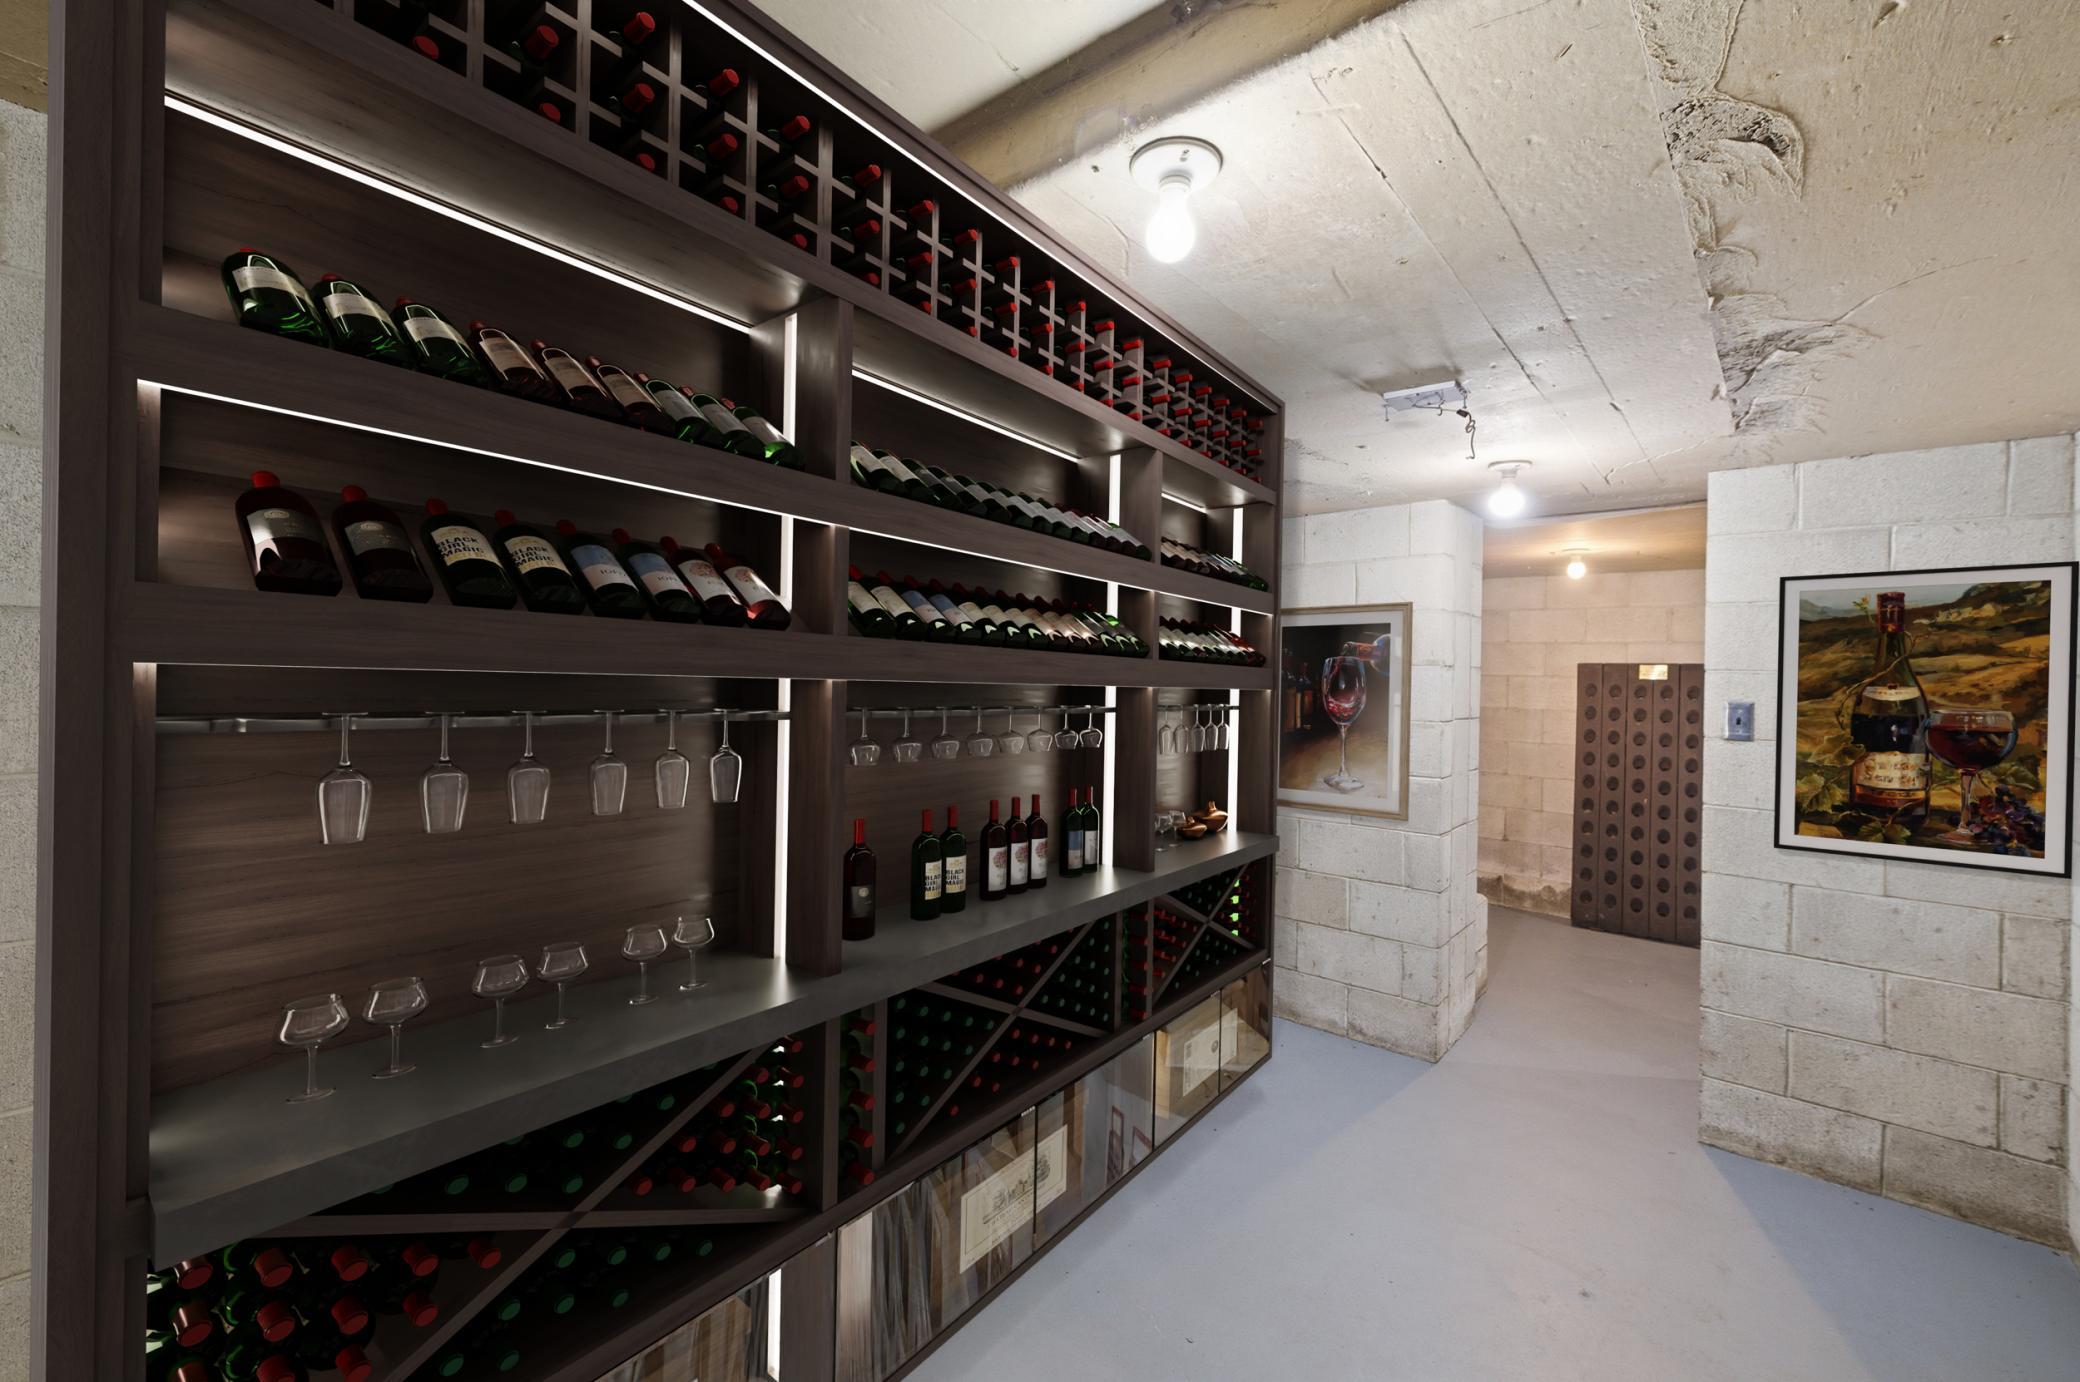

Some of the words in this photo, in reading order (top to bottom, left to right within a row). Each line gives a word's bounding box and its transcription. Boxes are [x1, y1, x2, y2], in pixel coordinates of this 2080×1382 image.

[436, 536, 479, 546] BLACK
[438, 541, 468, 552] GIRL
[440, 547, 484, 557] MAGIC
